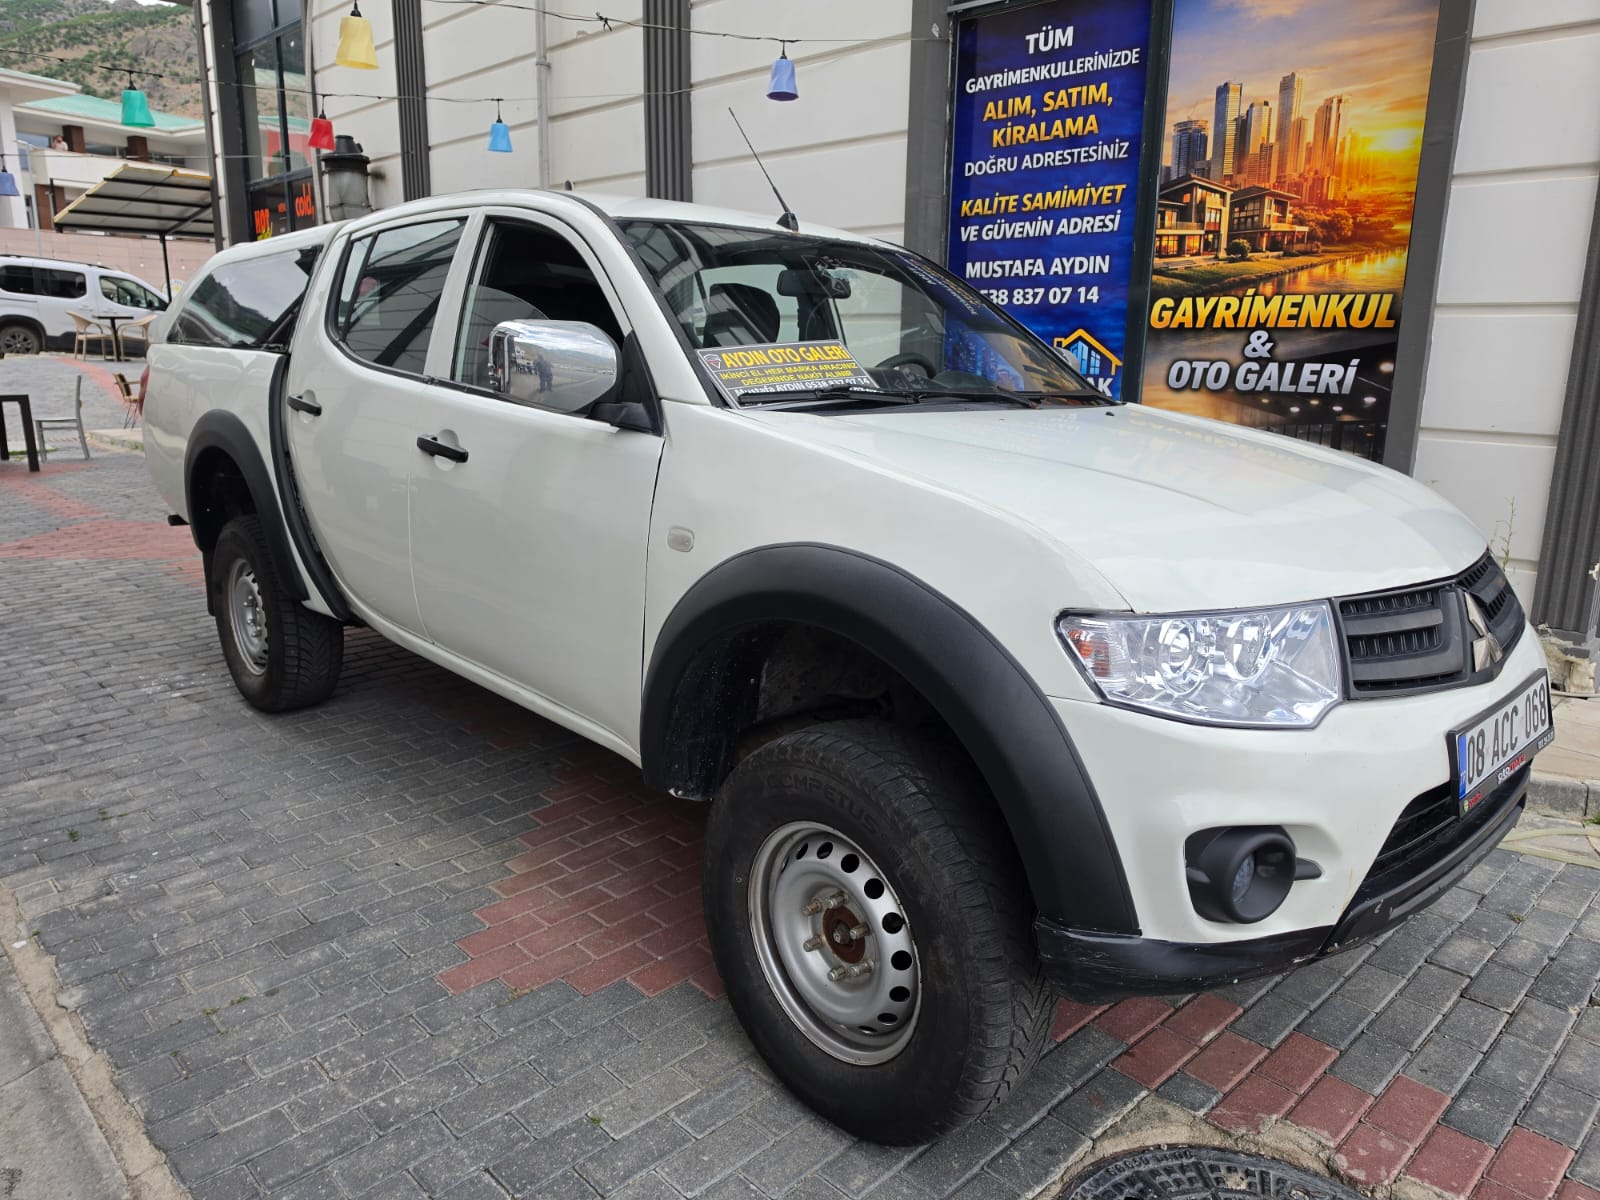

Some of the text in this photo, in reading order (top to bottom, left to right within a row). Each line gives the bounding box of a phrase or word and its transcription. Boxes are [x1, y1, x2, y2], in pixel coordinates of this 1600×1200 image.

[1025, 25, 1074, 54] TÜM
[965, 48, 1141, 93] GAYRİMENKULLERİNİZDE
[983, 82, 1113, 122] ALIM, SATIM,
[992, 114, 1100, 148] KİRALAMA
[964, 139, 1130, 177] DOĞRU ADRESTESİNİZ
[960, 182, 1127, 217] KALİTE SAMİMİYET
[960, 209, 1122, 242] VE GÜVENİN ADRESİ
[965, 255, 1110, 279] MUSTAFA AYDIN
[1012, 287, 1045, 305] 837
[1049, 287, 1073, 305] 07
[1077, 286, 1100, 303] 14
[1150, 288, 1396, 328] GAYRİMENKUL
[721, 345, 851, 369] AYDIN OTO GALERİ
[1243, 330, 1274, 359] &
[750, 369, 764, 377] EL
[764, 367, 785, 375] HER
[784, 365, 818, 374] MARKA
[804, 380, 828, 389] 0538
[858, 377, 871, 385] 14
[1168, 358, 1361, 395] OTO GALERİ
[1467, 729, 1485, 785] 08
[1491, 705, 1518, 767] ACC
[1525, 683, 1547, 739] 068
